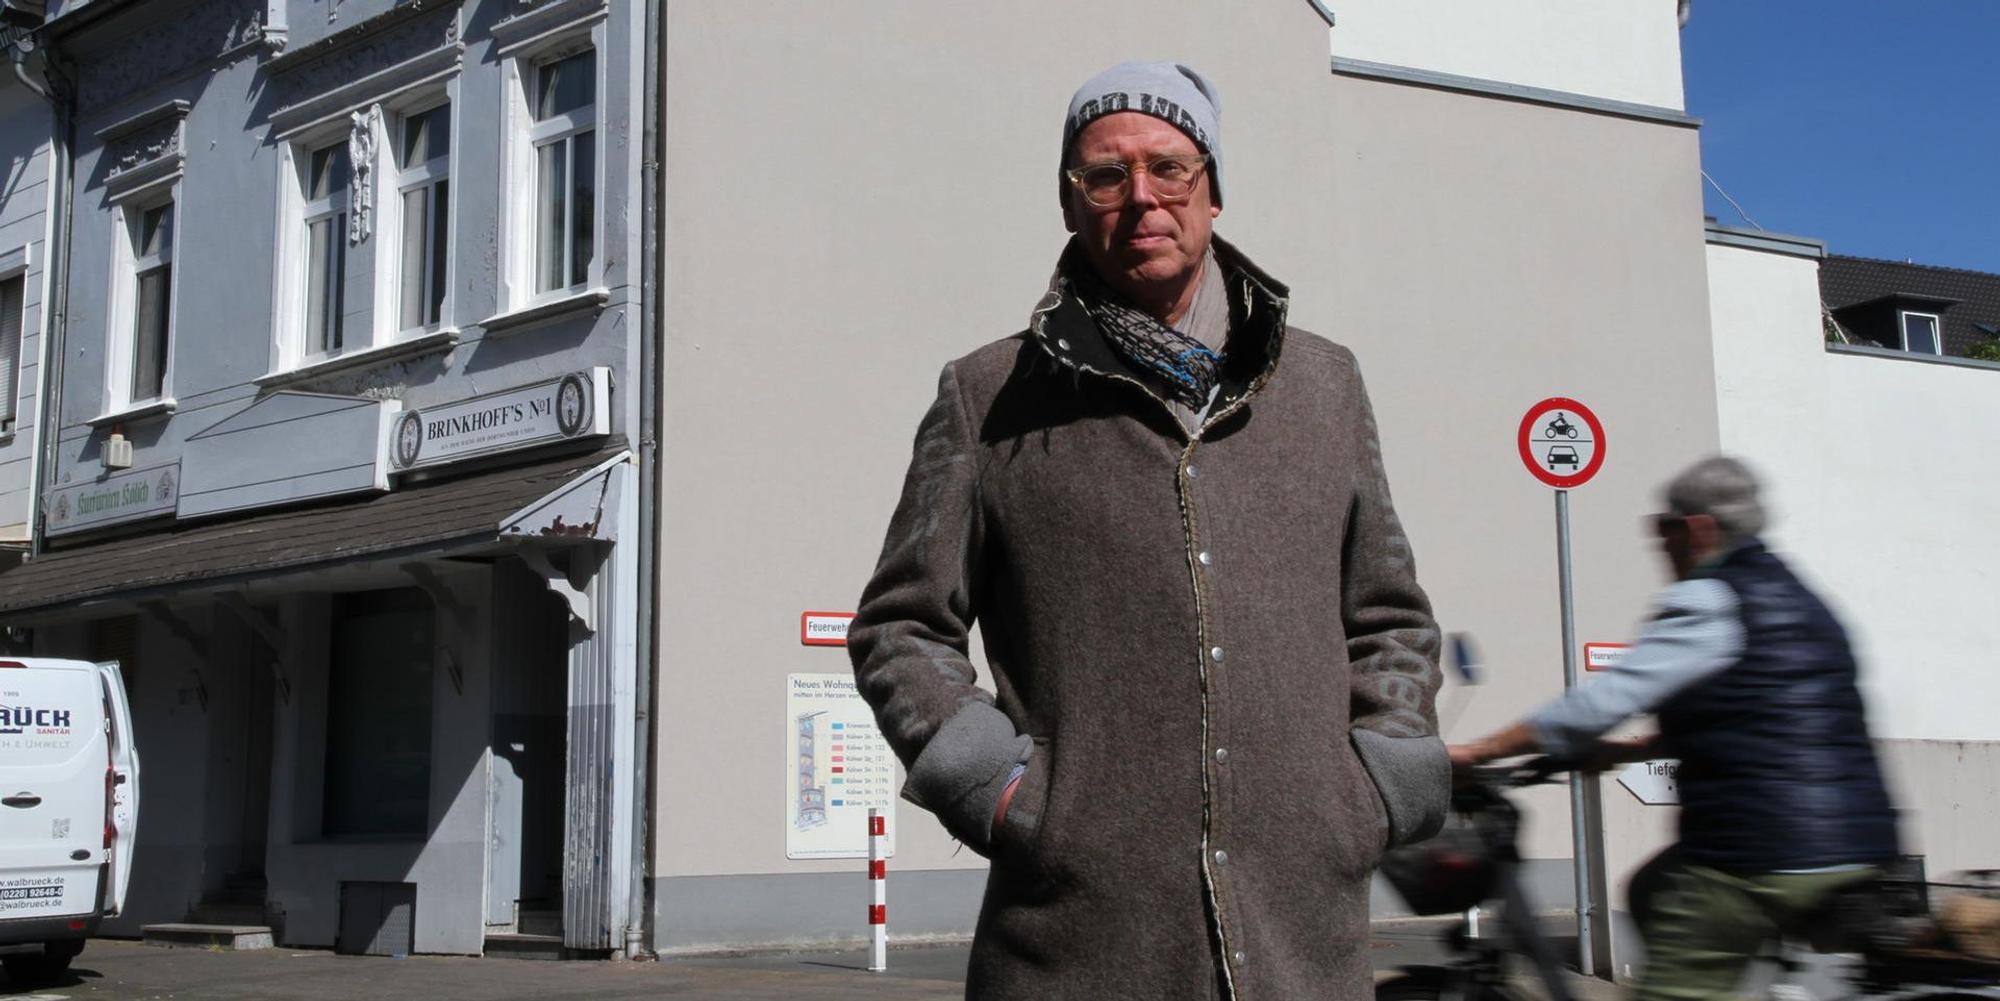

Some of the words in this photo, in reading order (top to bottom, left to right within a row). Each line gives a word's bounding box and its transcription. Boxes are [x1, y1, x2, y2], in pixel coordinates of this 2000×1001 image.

[427, 402, 524, 441] BRINKHOFF'S
[808, 621, 848, 633] Feuerweh
[794, 679, 821, 689] Neues
[0, 889, 28, 899] (0228)
[29, 887, 63, 898] 92648-0
